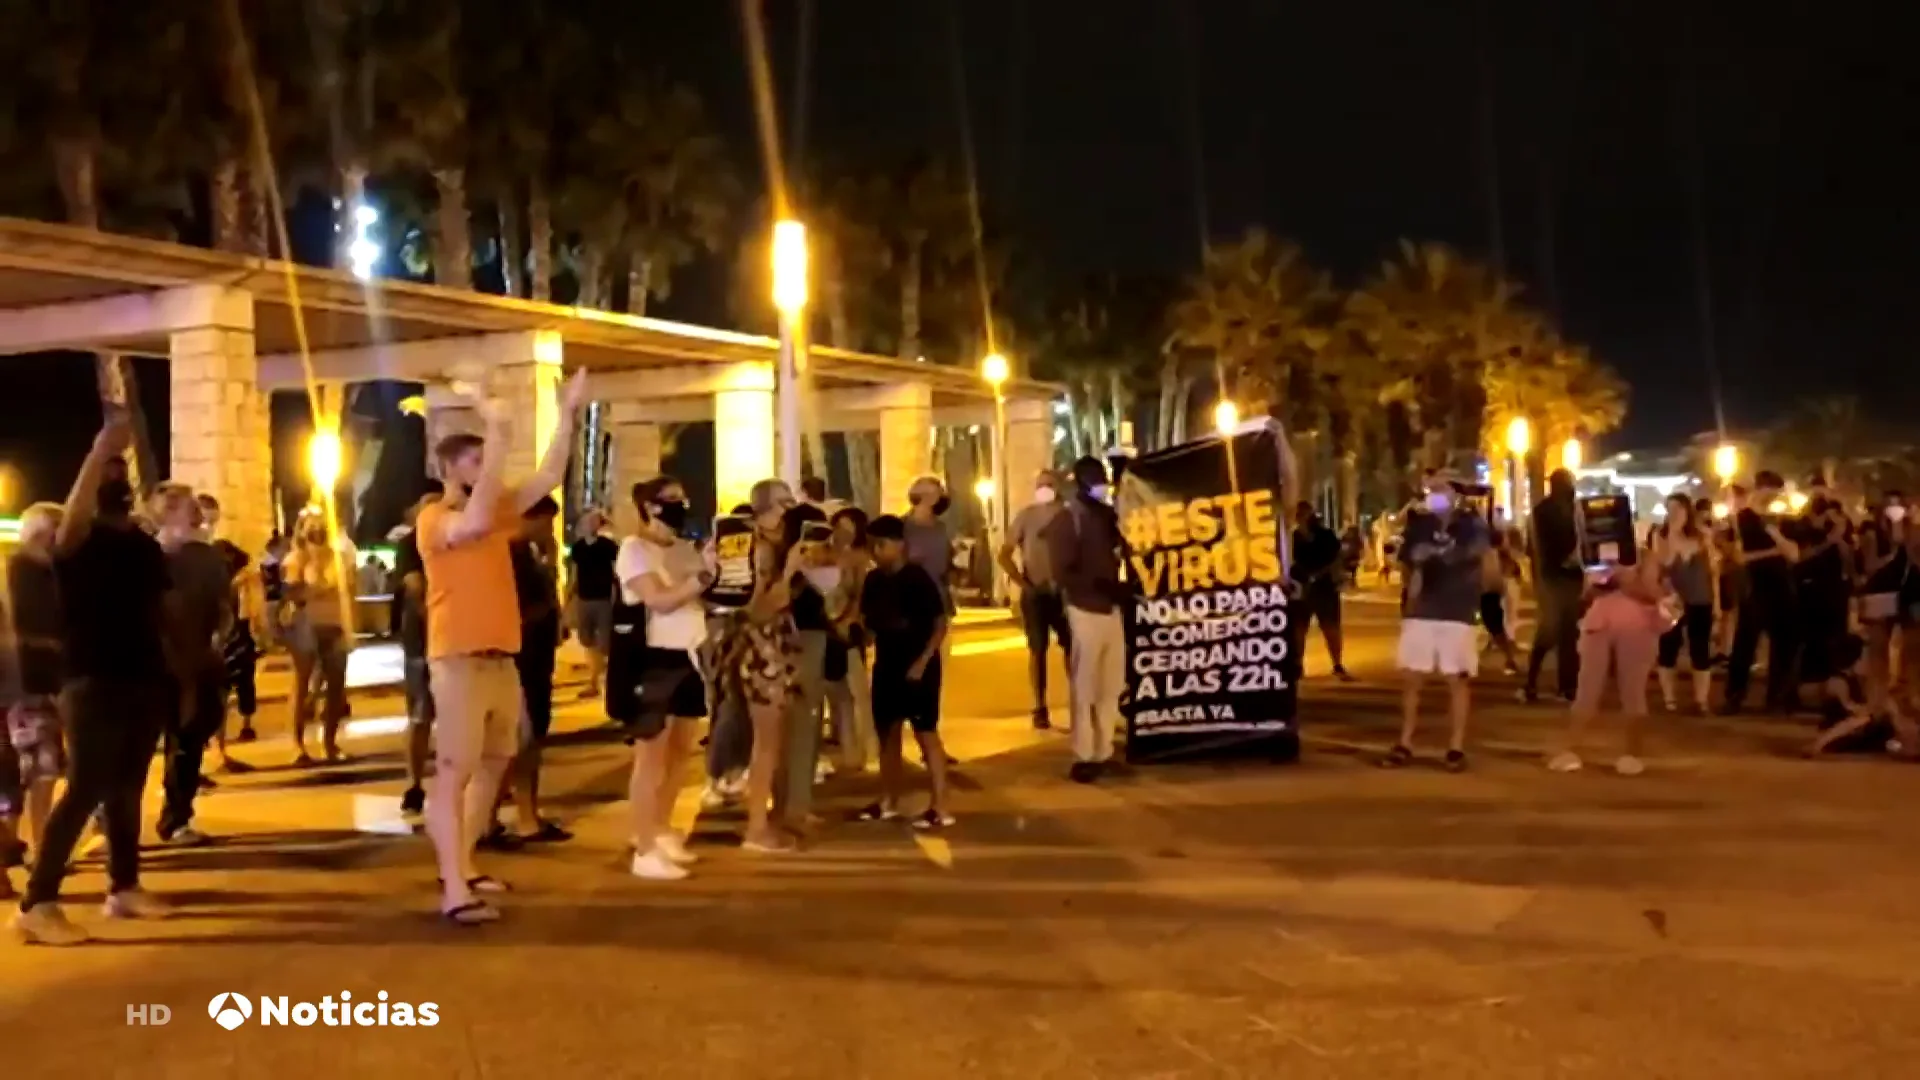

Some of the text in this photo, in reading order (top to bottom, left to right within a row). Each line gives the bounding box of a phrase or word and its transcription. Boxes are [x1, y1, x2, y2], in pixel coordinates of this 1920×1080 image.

[1125, 489, 1277, 551] #ESTE
[1130, 537, 1281, 598] VIRUS
[1136, 584, 1287, 625] NO LO PARA
[1152, 609, 1288, 647] COMERCIO
[1134, 636, 1288, 675] CERRANDO
[1135, 662, 1288, 701] A LAS 22h.
[1209, 703, 1236, 720] YA
